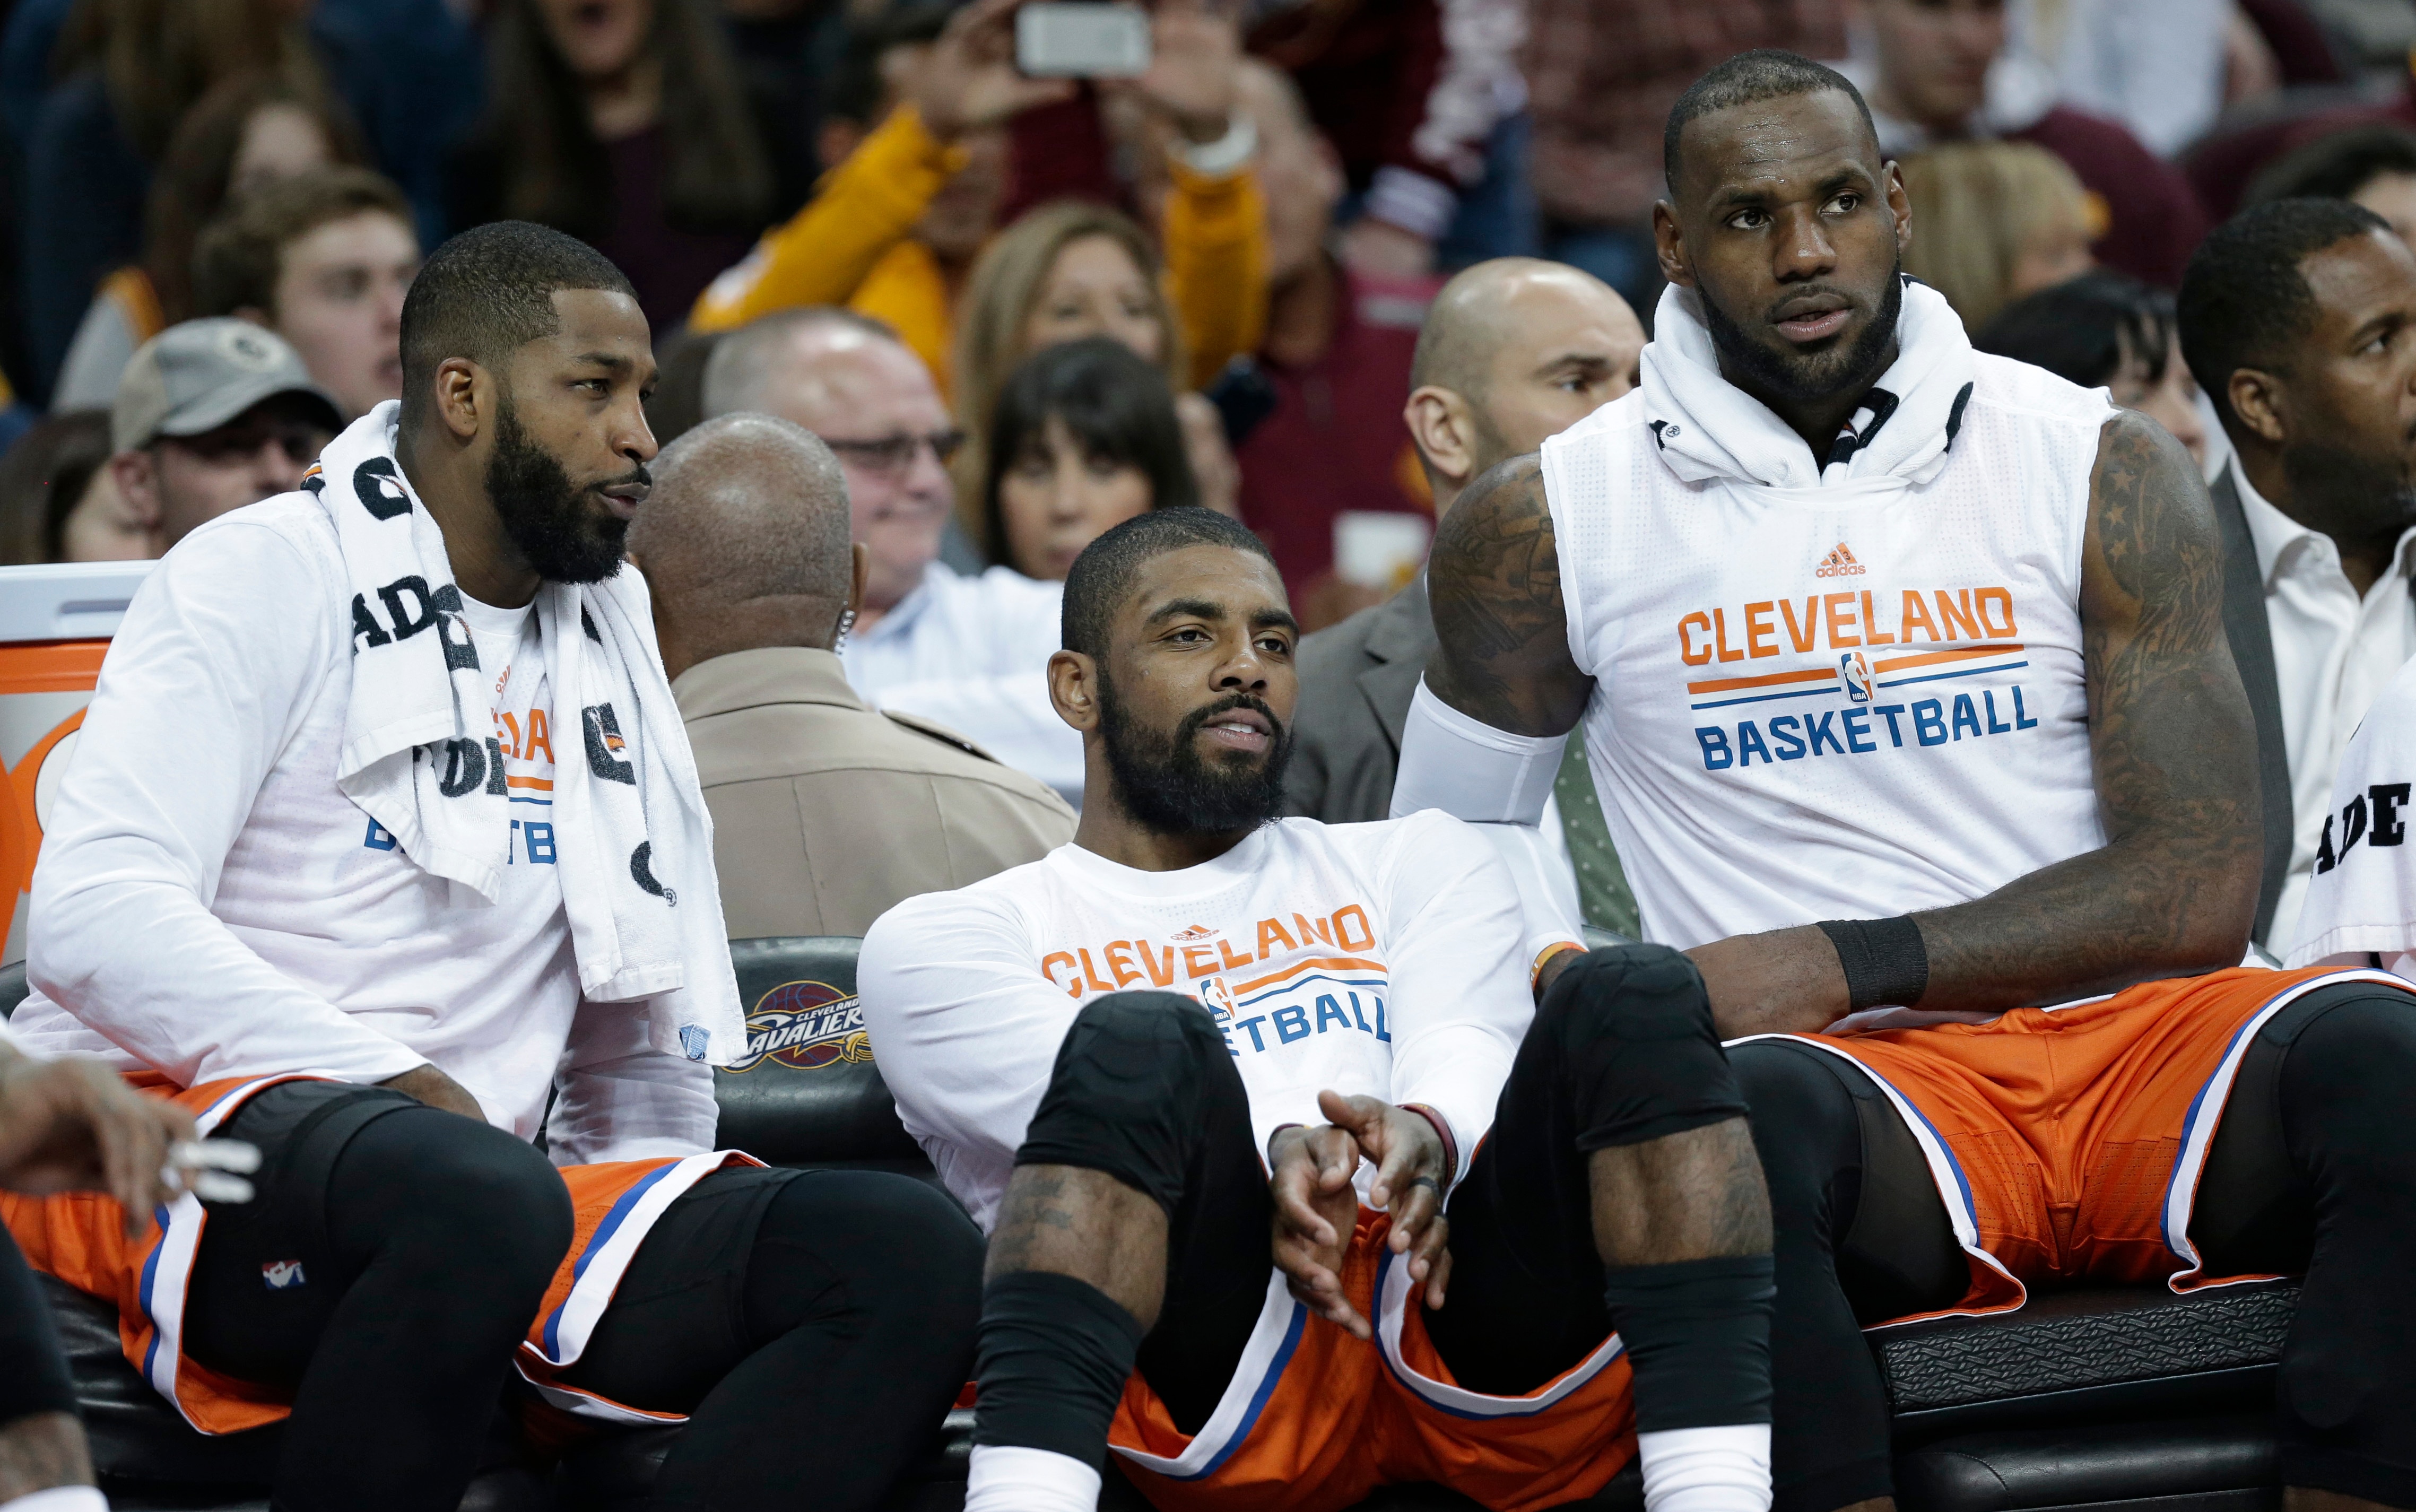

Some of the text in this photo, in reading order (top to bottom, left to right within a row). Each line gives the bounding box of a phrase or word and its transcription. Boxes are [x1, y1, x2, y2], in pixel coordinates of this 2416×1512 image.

[1815, 563, 1866, 578] adidas
[1678, 586, 2018, 666] CLEVELAND
[1695, 685, 2038, 770] BASKETBALL
[1041, 903, 1377, 999] CLEVELAND
[1170, 929, 1220, 941] adidas
[796, 998, 859, 1022] CLEVELAND
[1214, 1012, 1229, 1021] NBA
[727, 1006, 864, 1068] CAVALIER
